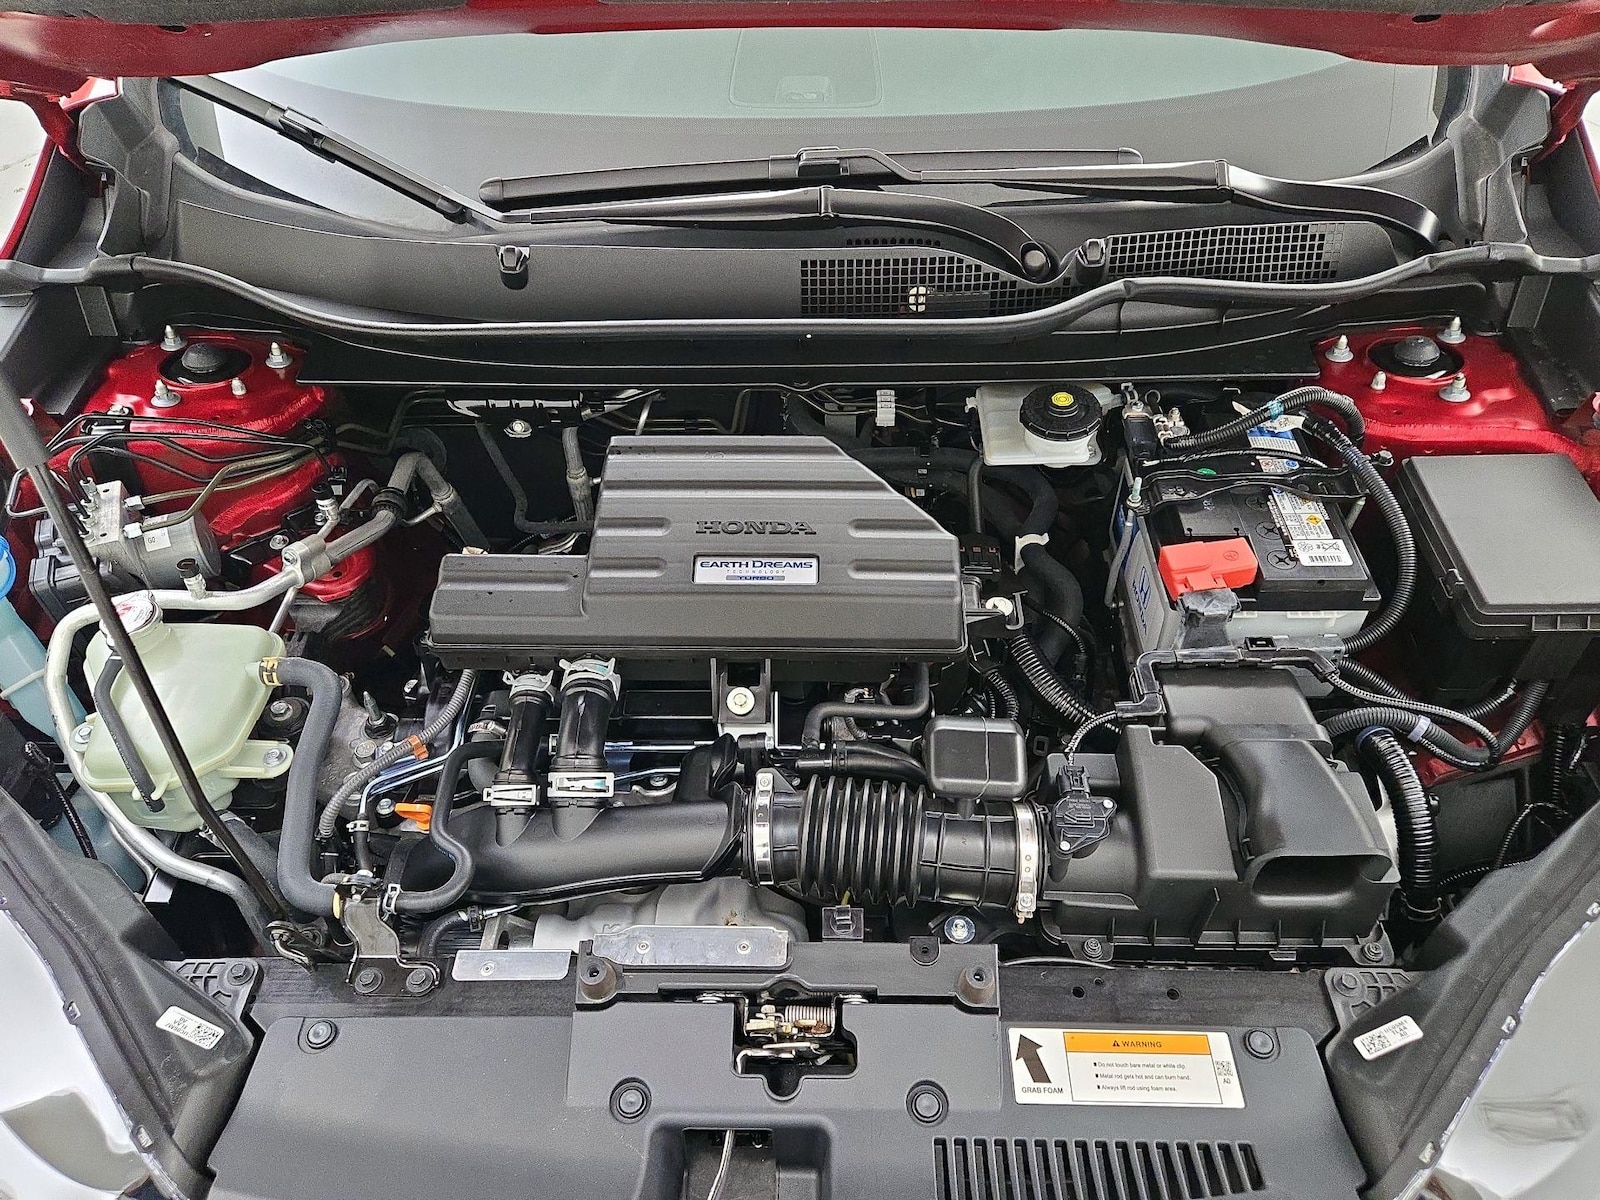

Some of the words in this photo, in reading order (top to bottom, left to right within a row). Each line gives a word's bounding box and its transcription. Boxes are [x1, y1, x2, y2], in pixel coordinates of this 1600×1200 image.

[695, 520, 817, 535] HONDA
[700, 560, 749, 569] EARTH
[752, 560, 813, 569] DREAMS
[1121, 1040, 1163, 1048] WARNING
[1021, 1086, 1042, 1094] GRAB
[1043, 1087, 1064, 1095] FOAM
